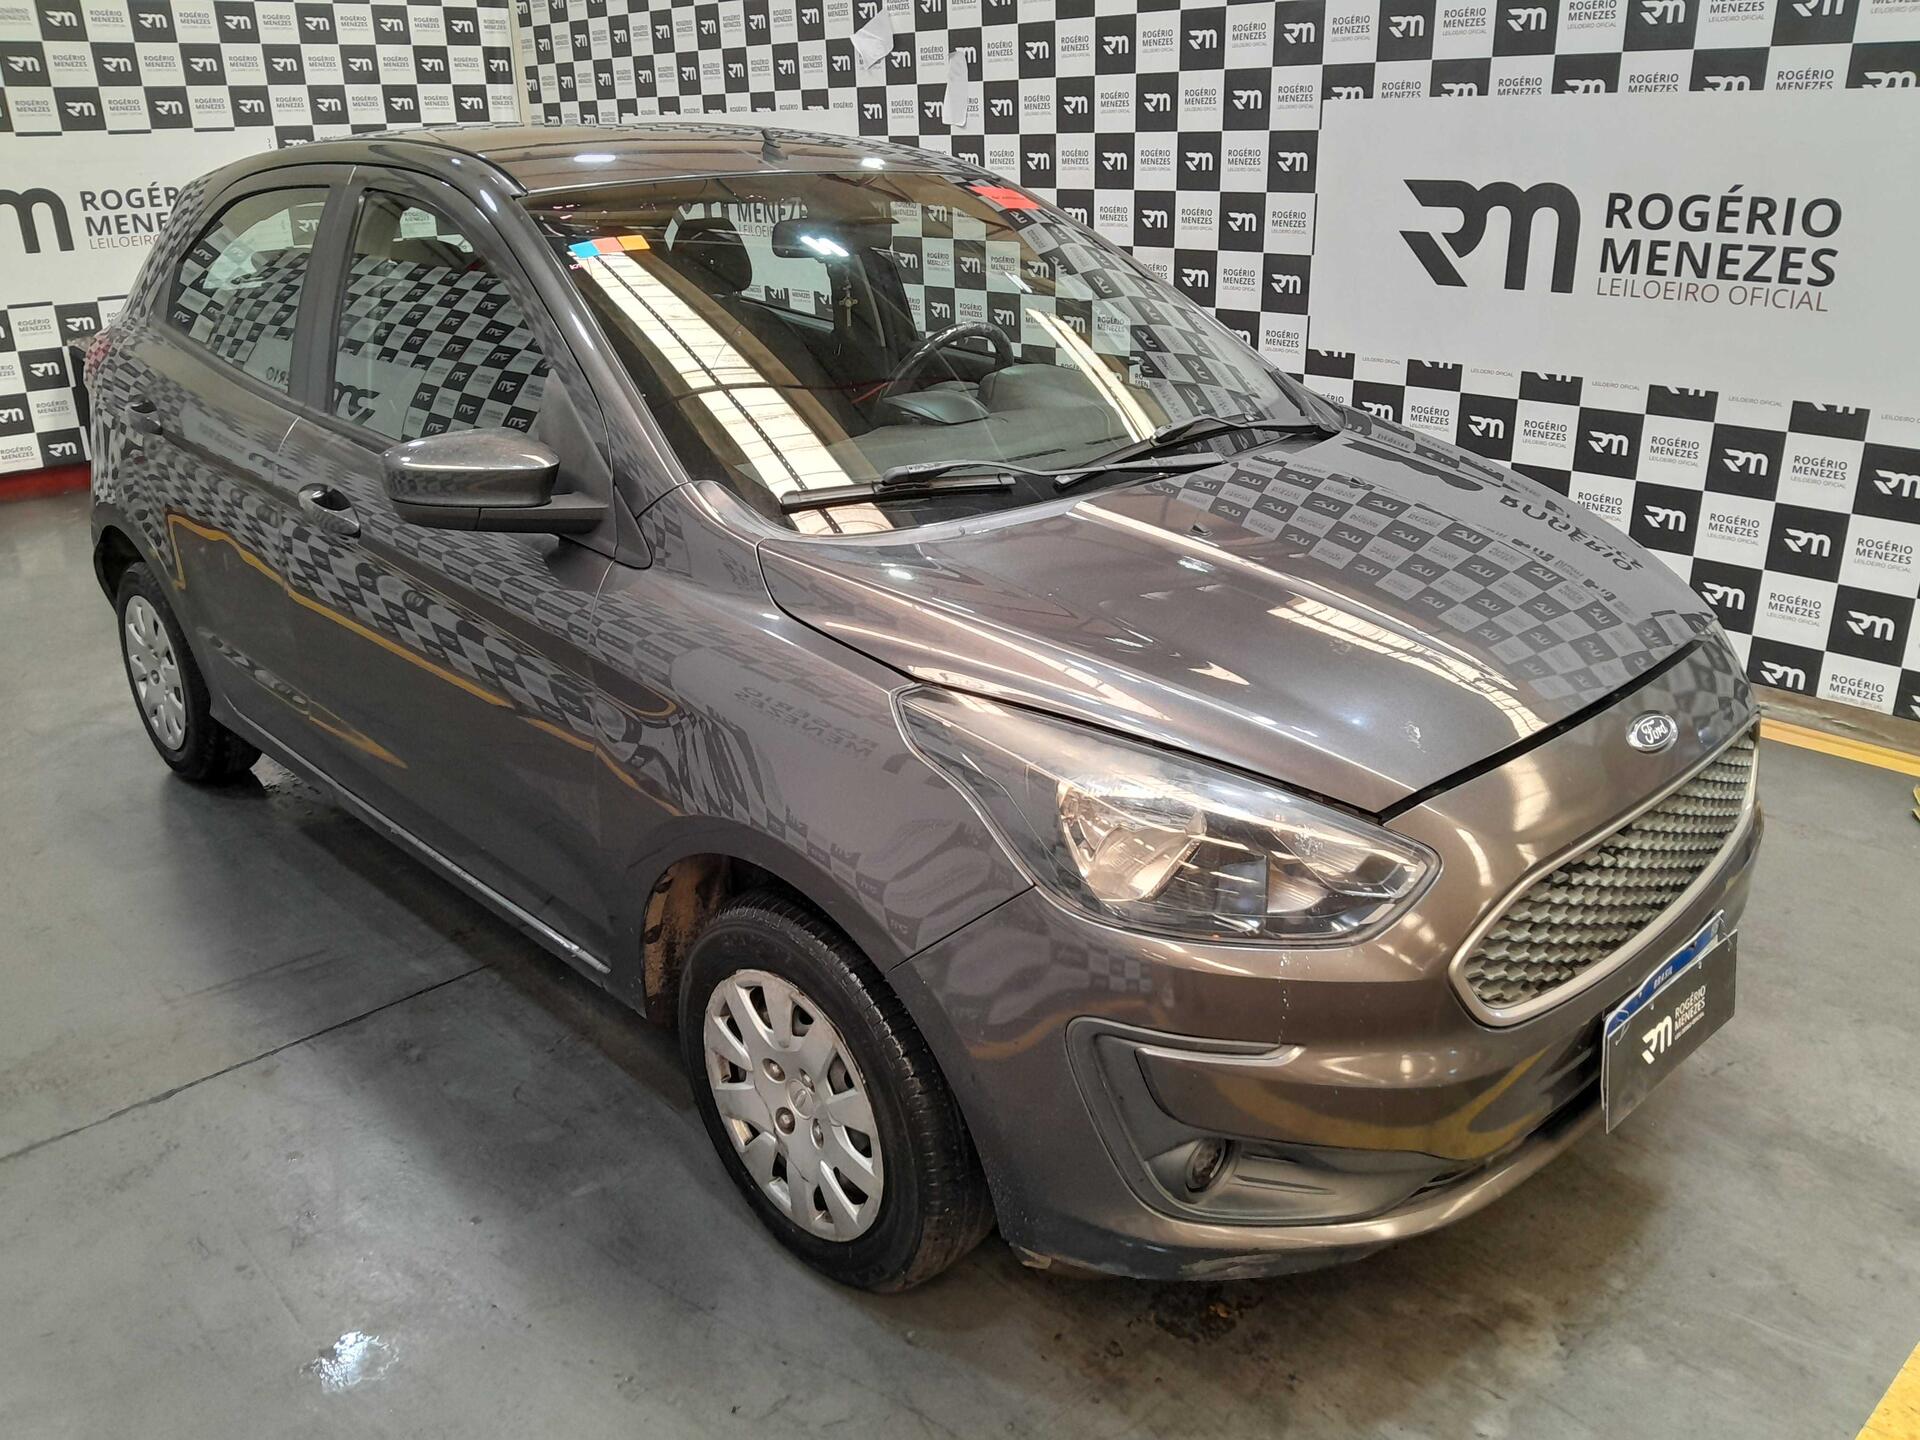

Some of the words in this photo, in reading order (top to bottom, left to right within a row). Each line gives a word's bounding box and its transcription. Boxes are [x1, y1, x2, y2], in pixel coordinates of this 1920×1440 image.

[1444, 8, 1486, 18] ROGÉRIO
[1710, 2, 1764, 14] MENEZES
[1332, 15, 1370, 25] ROGÉRIO
[1568, 9, 1616, 22] MENEZES
[1443, 17, 1486, 28] MENEZES
[1332, 24, 1370, 35] MENEZES
[1629, 72, 1679, 84] ROGÉRIO
[1777, 68, 1834, 81] ROGÉRIO
[1382, 80, 1421, 90] ROGÉRIO
[1498, 76, 1542, 87] ROGÉRIO
[1061, 157, 1089, 165] MENEZES
[1140, 157, 1171, 166] MENEZES
[1227, 156, 1261, 166] MENEZES
[80, 182, 179, 211] ROGÉR
[1100, 213, 1128, 222] MENEZES
[1605, 185, 1842, 237] ROGÉRIO
[85, 212, 168, 236] MENE
[1181, 216, 1212, 225] MENEZES
[1272, 218, 1306, 228] MENEZES
[1599, 237, 1838, 287] MENEZES
[1223, 276, 1255, 285] MENEZES
[1597, 277, 1719, 304] LEILOEIRO
[1729, 286, 1828, 312] OFICIAL
[1265, 337, 1299, 348] MENEZES
[1411, 405, 1450, 417] ROGÉRIO
[1410, 414, 1449, 426] MENEZES
[1524, 420, 1567, 433] ROGÉRIO
[1523, 429, 1567, 442] MENEZES
[1651, 436, 1699, 449] ROGÉRIO
[1650, 446, 1699, 459] MENEZES
[1794, 455, 1848, 470] ROGÉRIO
[1792, 465, 1847, 480] MENEZES
[1710, 513, 1760, 528] ROGÉRIO
[1708, 523, 1759, 538] MENEZES
[1857, 537, 1913, 554] ROGÉRIO
[1855, 547, 1912, 565] MENEZES
[1770, 592, 1821, 609] ROGÉRIO
[1768, 602, 1820, 619] MENEZES
[1831, 673, 1884, 692] ROGÉRIO
[1829, 683, 1883, 702] MENEZES
[1641, 720, 1668, 744] Ford
[1675, 985, 1706, 1018] ROGÉRIO
[1675, 997, 1705, 1032] MENEZES
